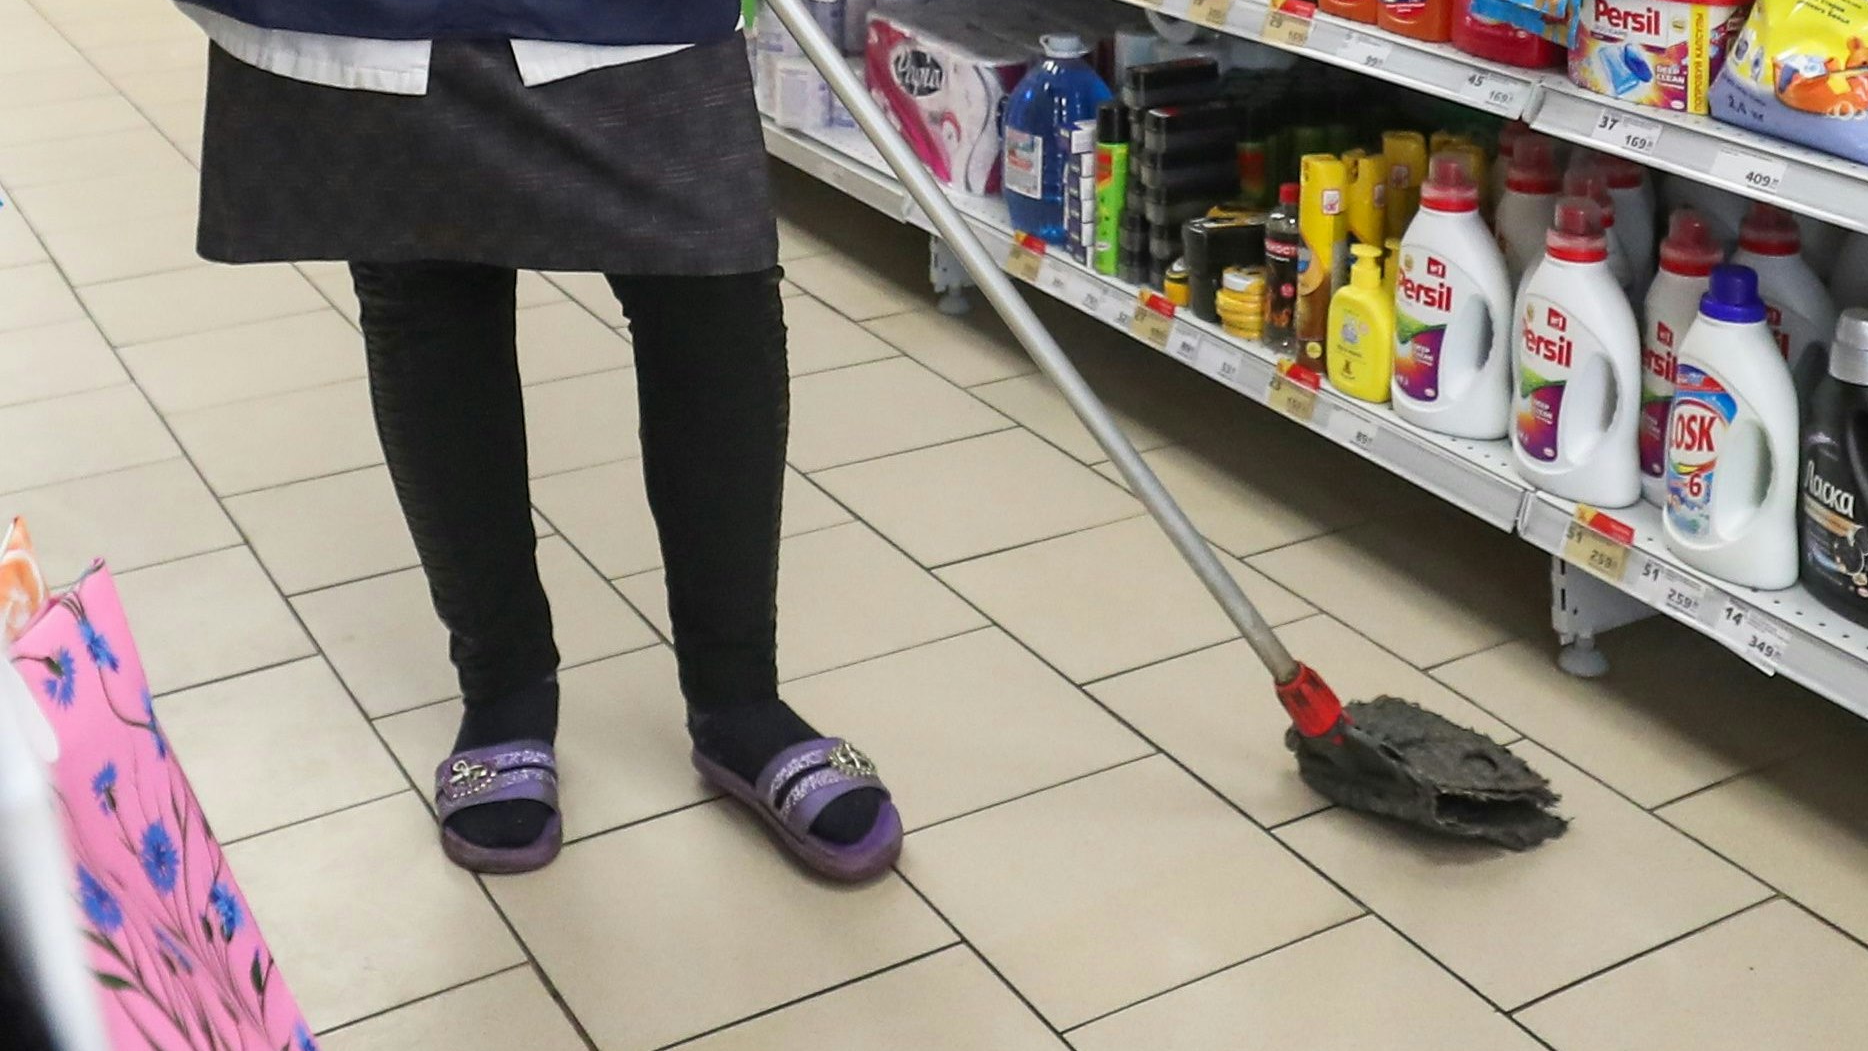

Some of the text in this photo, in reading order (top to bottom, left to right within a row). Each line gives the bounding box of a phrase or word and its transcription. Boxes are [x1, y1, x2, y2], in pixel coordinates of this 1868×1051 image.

[1656, 74, 1685, 85] CLEAN
[1599, 117, 1619, 131] 37
[1624, 133, 1648, 148] 169
[1745, 172, 1771, 186] 409
[1688, 473, 1701, 497] 6
[1803, 461, 1855, 516] Ласка
[1666, 588, 1693, 609] 259
[1724, 606, 1744, 626] 14
[1748, 635, 1773, 656] 349
